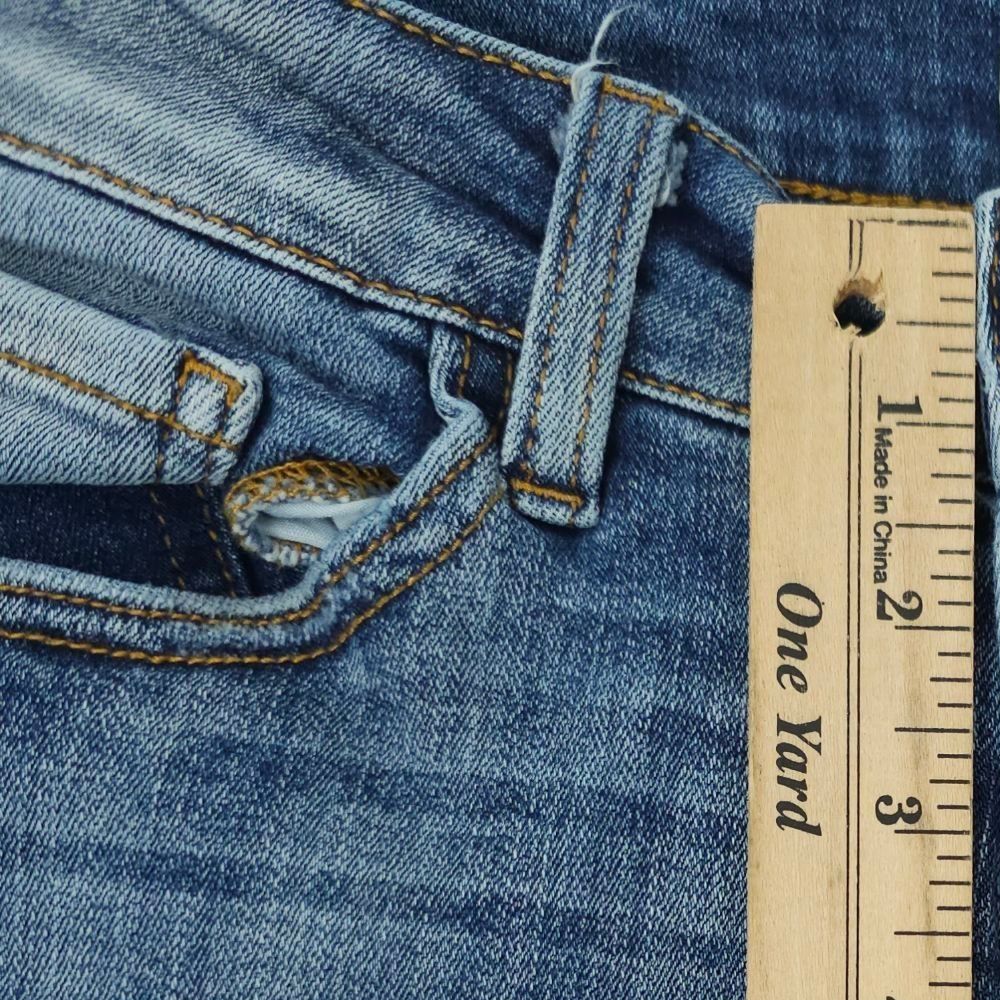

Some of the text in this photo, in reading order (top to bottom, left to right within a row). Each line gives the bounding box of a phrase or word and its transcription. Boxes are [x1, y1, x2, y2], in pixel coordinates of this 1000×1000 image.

[877, 395, 923, 422] 1
[873, 427, 893, 584] Made in China
[876, 589, 923, 621] 2
[775, 582, 823, 836] One Yard
[875, 794, 922, 825] 3
